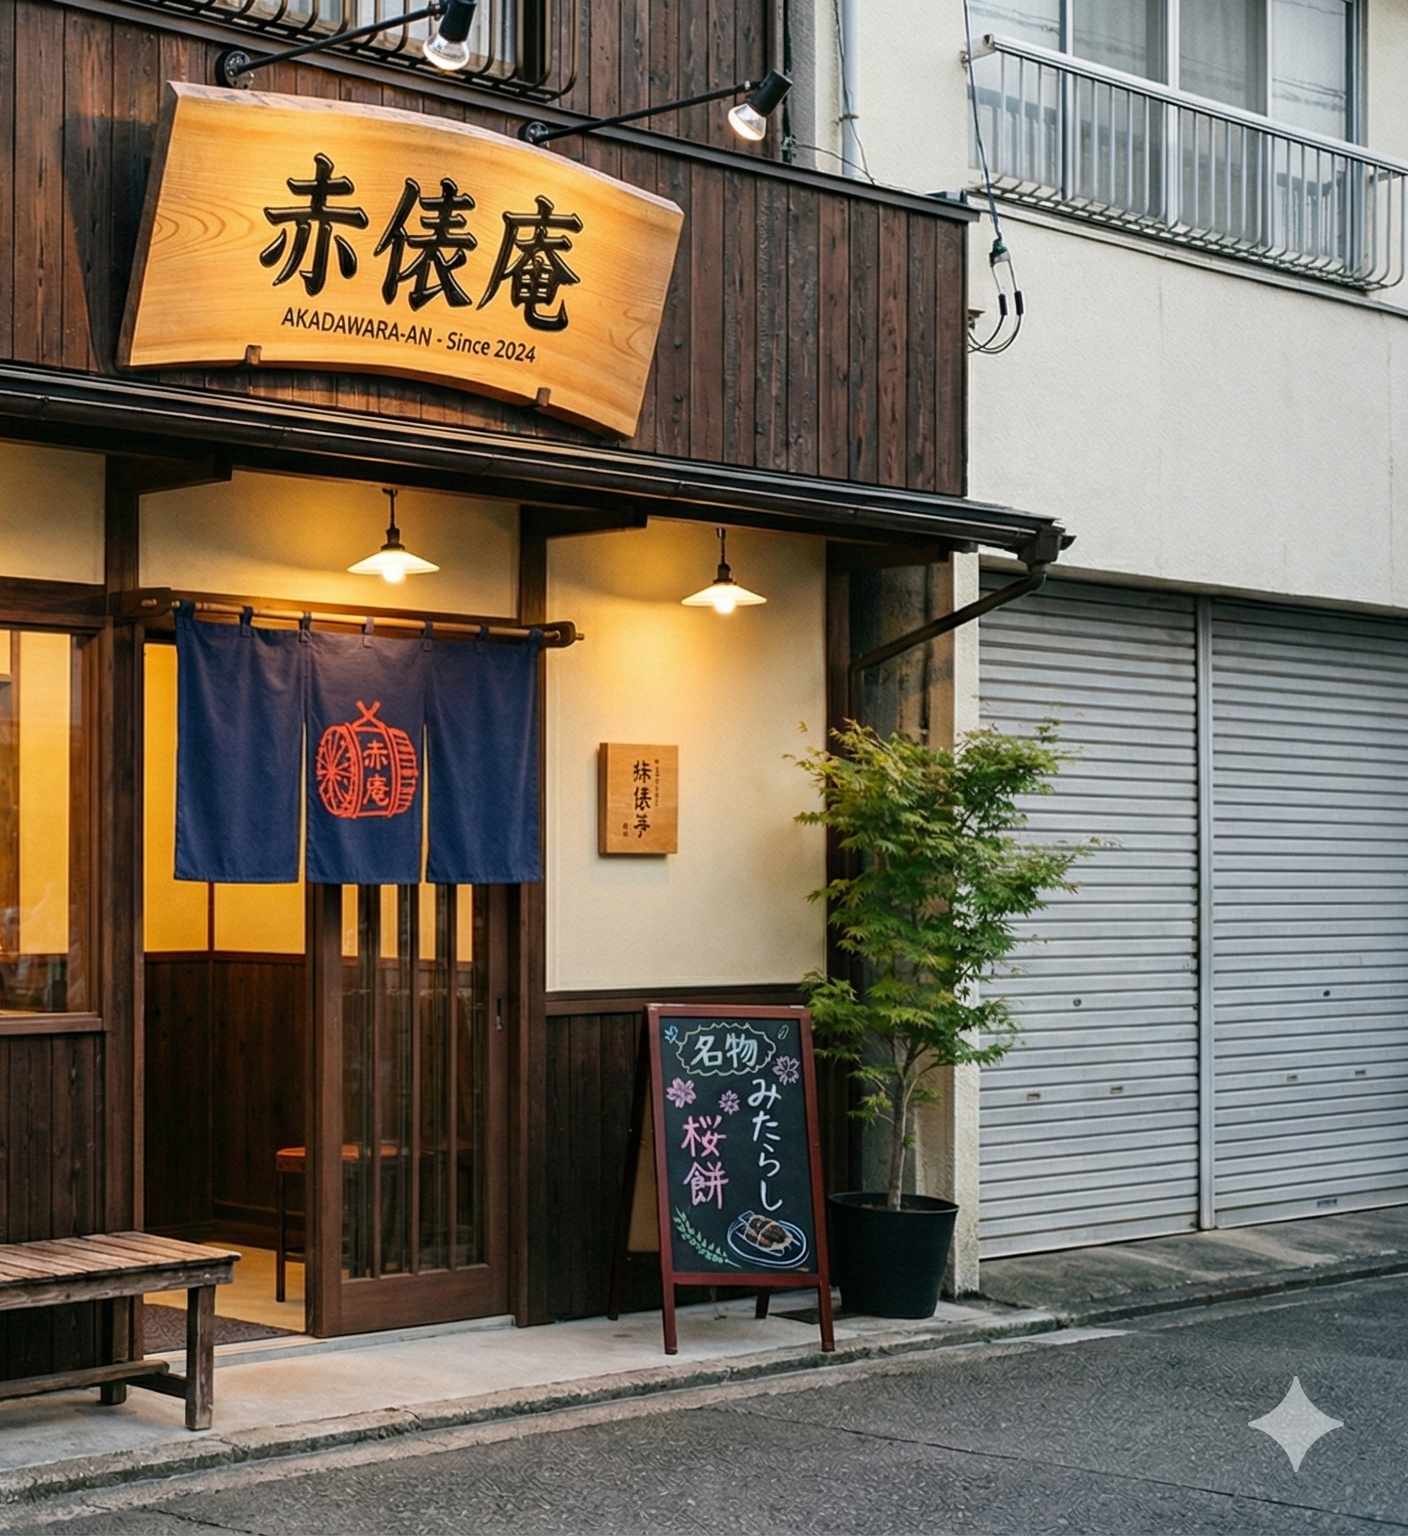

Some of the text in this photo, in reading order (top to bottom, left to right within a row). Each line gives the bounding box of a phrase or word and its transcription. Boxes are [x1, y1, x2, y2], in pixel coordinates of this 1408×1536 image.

[259, 152, 584, 333] 赤俵庵
[281, 306, 433, 347] AKADAWARA-AN
[446, 331, 491, 356] Since
[493, 339, 536, 363] 2024
[363, 739, 389, 807] 赤庵
[690, 1032, 758, 1068] 名物
[680, 1114, 729, 1210] 桜餅
[747, 1077, 783, 1212] みたらし
